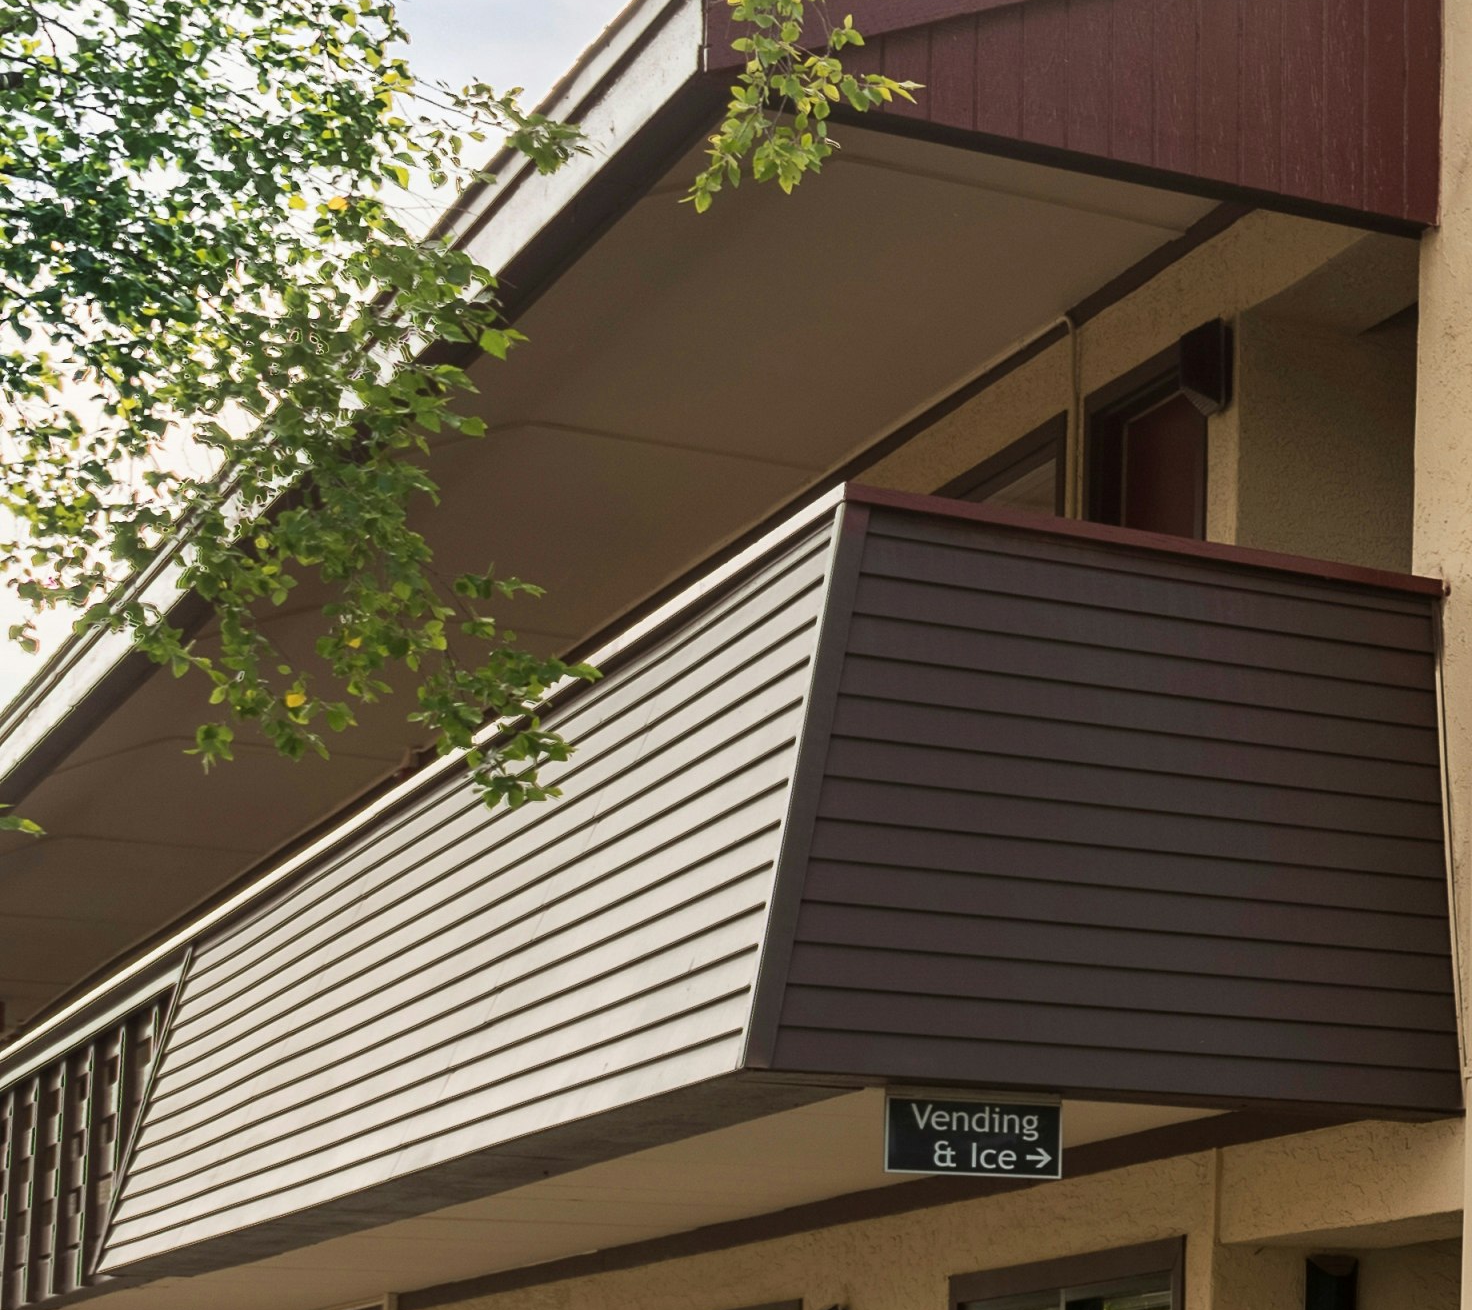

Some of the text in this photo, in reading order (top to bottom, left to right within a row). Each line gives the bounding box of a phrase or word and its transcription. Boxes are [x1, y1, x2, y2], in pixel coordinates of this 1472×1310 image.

[911, 1102, 1039, 1142] Vending
[933, 1140, 1018, 1170] & Ice
